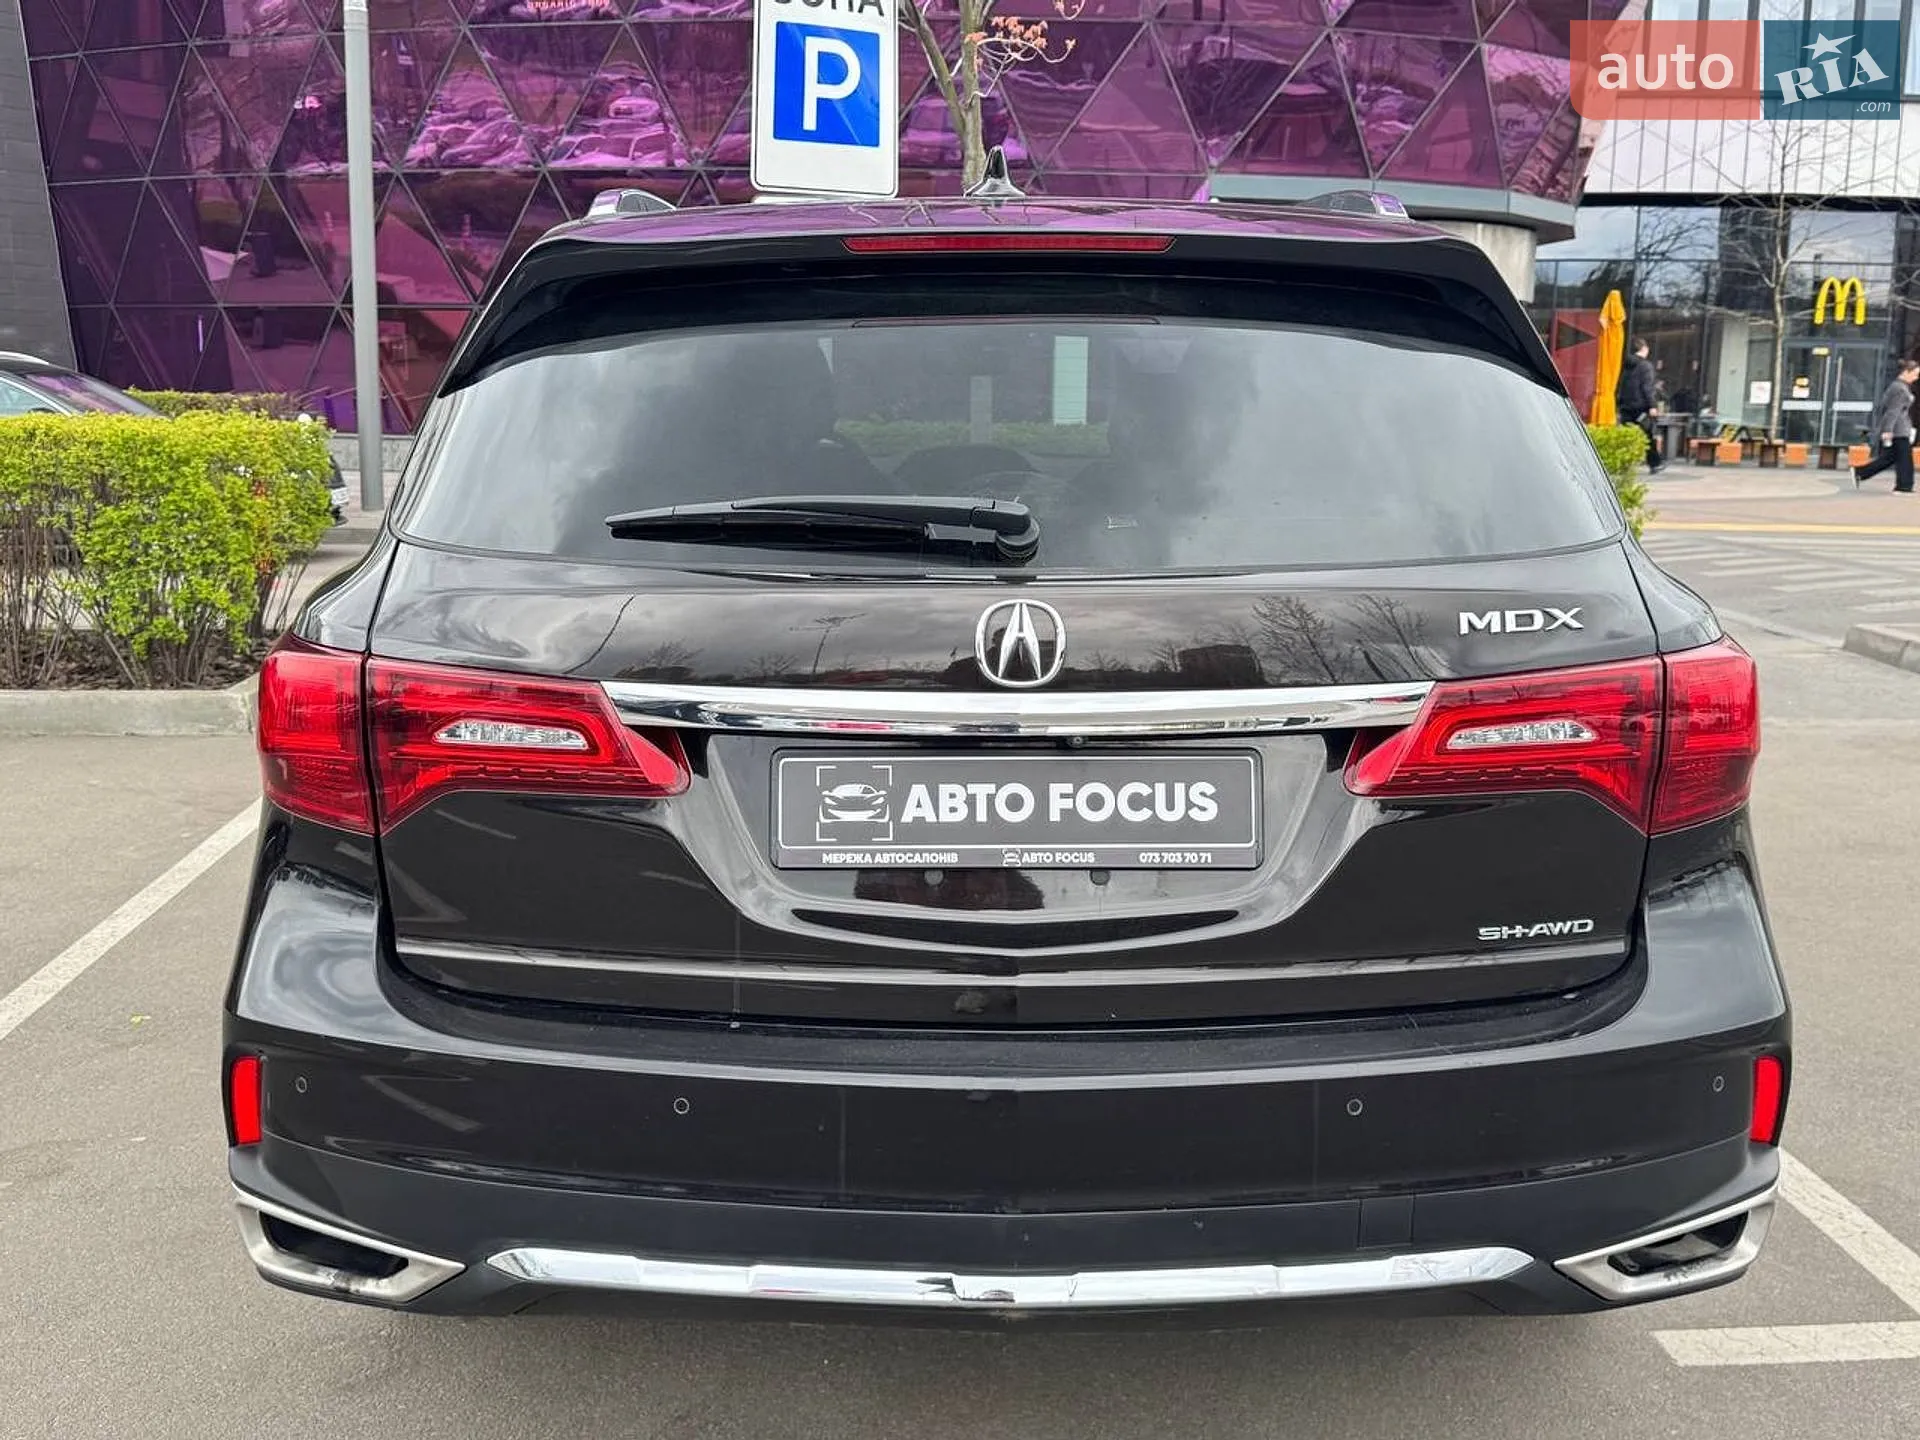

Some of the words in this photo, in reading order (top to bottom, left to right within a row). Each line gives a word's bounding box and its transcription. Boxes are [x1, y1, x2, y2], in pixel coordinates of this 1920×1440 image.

[802, 35, 862, 131] P
[1459, 607, 1585, 635] MDX
[901, 783, 1035, 824] АВТО
[1049, 781, 1219, 823] FOCUS
[822, 853, 872, 864] МЕРЕЖА
[874, 852, 959, 864] АВТОСАЛОНІВ
[1022, 851, 1053, 864] АВТО
[1055, 851, 1095, 864] FOCUS
[1139, 852, 1160, 864] 073
[1161, 852, 1182, 864] 703
[1183, 852, 1198, 864] 70
[1199, 852, 1212, 864] 71
[1478, 919, 1594, 940] SH-AWD
